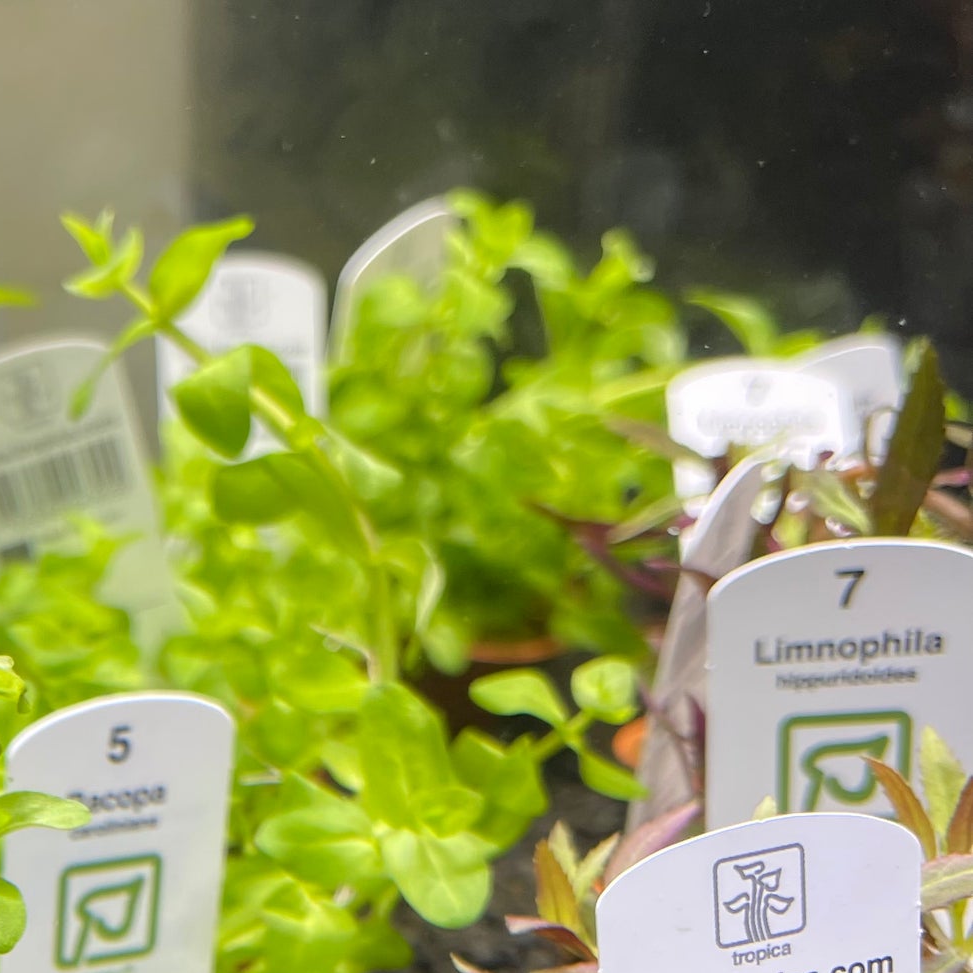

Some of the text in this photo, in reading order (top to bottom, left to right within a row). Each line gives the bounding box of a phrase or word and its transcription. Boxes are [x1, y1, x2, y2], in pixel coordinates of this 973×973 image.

[834, 566, 867, 609] 7
[753, 628, 945, 666] Limnophila
[107, 724, 132, 764] 5
[732, 942, 792, 966] tropica
